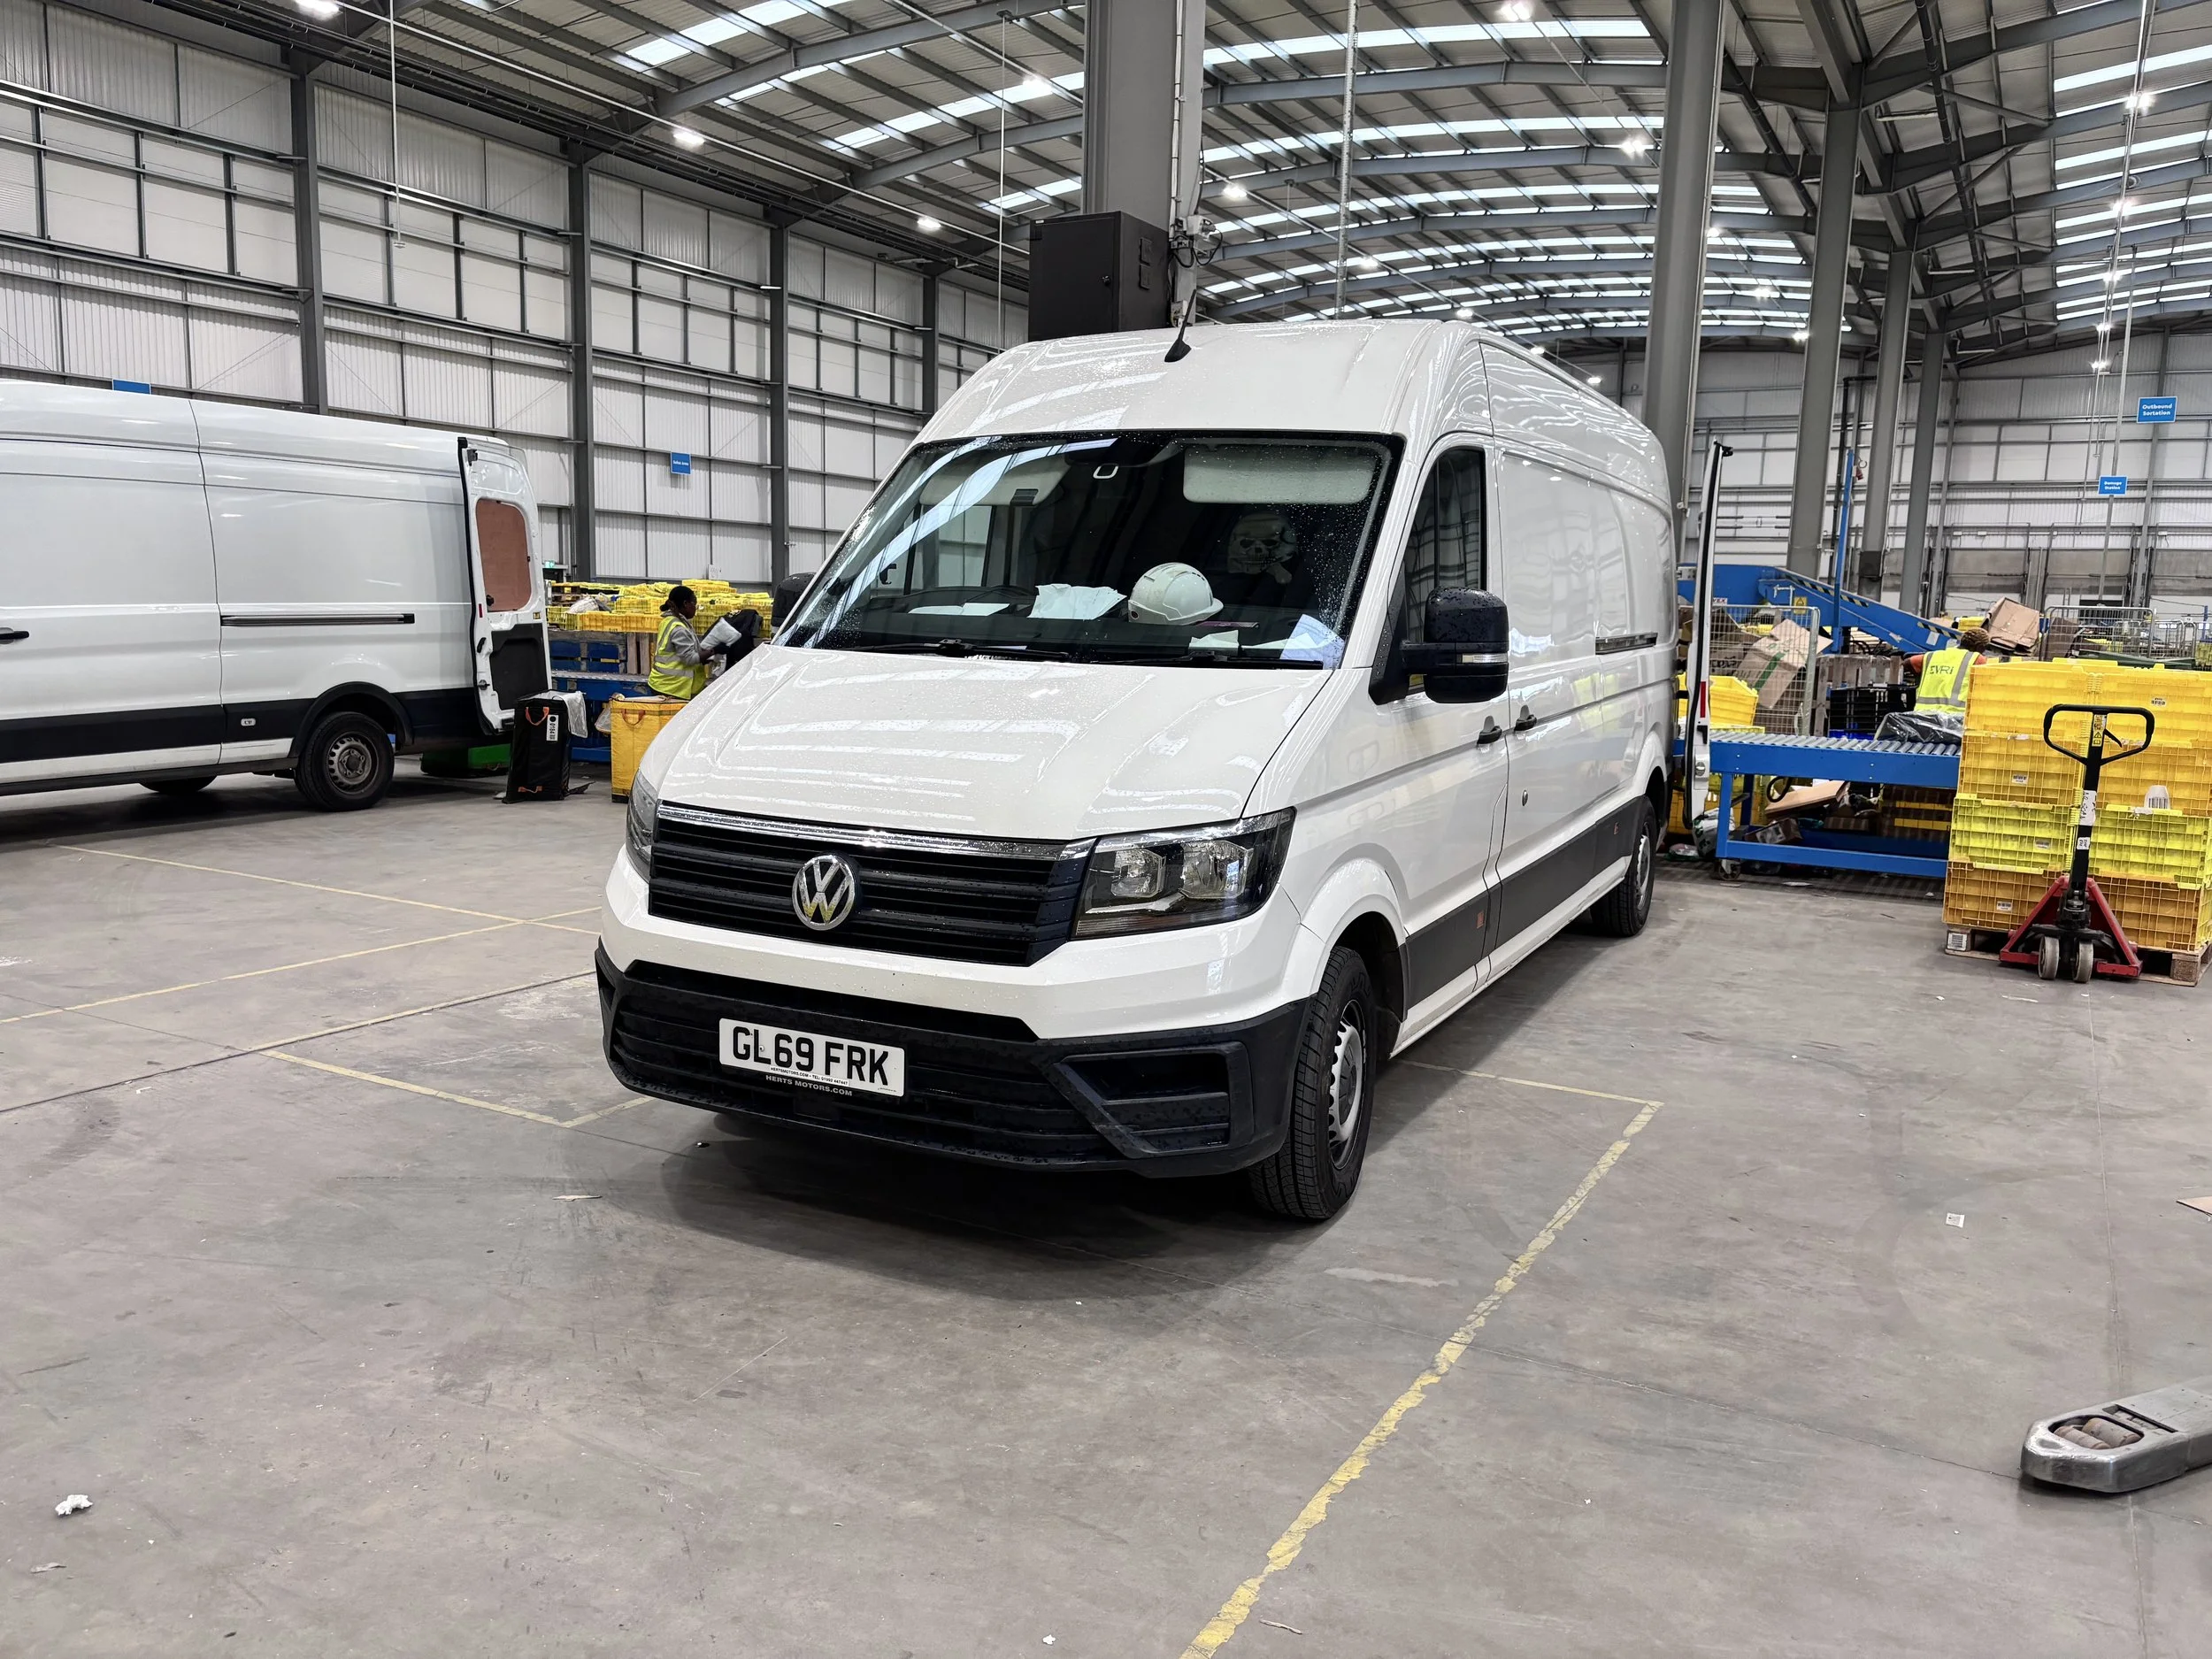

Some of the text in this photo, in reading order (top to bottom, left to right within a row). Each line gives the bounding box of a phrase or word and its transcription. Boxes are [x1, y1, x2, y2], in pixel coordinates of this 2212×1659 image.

[733, 1025, 889, 1086] GL69 FRK
[765, 1074, 853, 1096] HERTS MOTORS.COM
